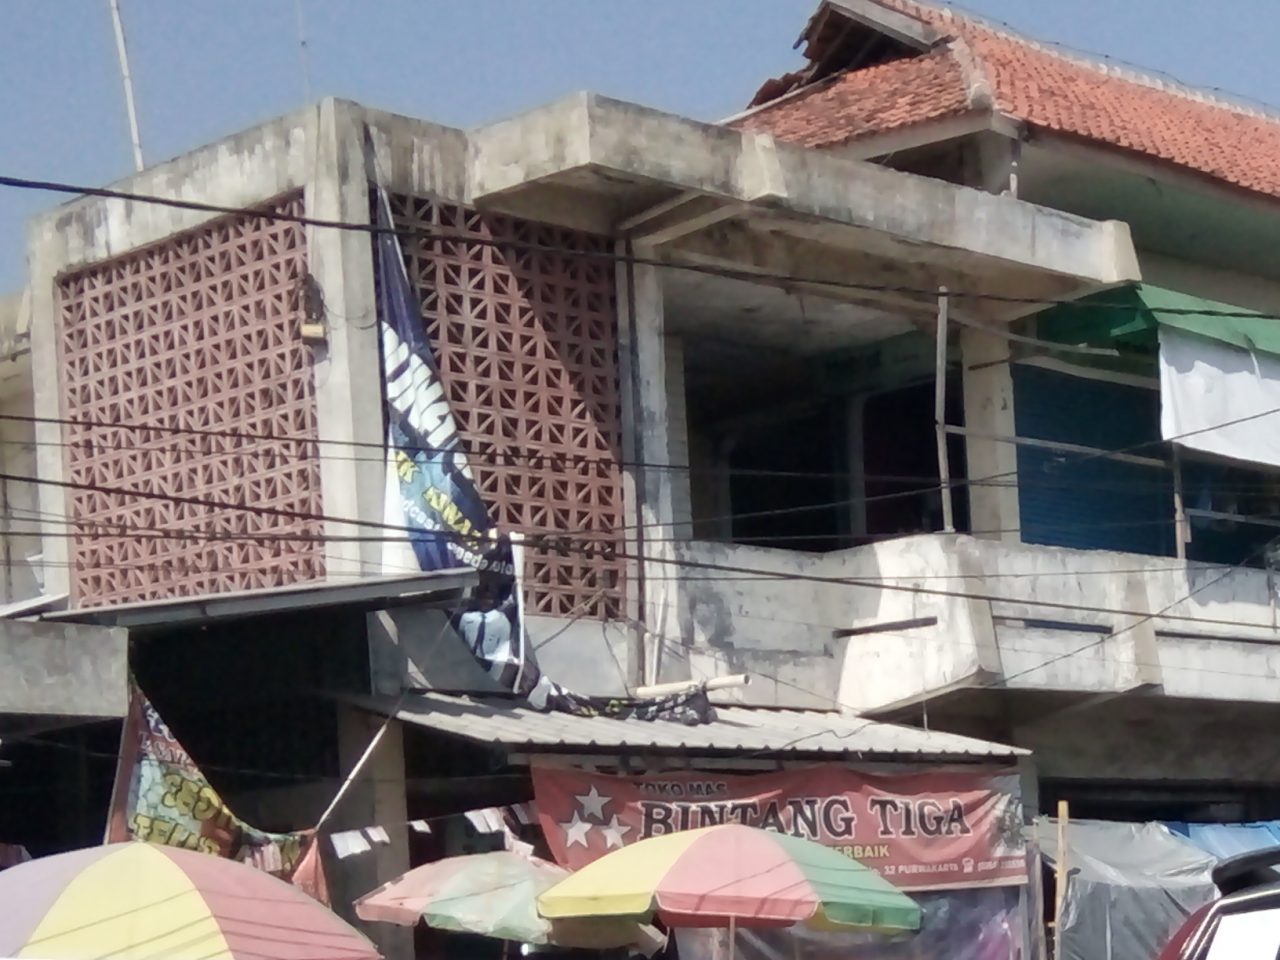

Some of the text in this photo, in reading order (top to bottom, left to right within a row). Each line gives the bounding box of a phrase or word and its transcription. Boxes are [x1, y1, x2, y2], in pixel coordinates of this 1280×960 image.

[633, 781, 729, 797] TOKO MAS
[637, 796, 973, 842] BINTANG TIGA
[834, 844, 890, 859] ERBAIK
[898, 861, 959, 874] PURWAKARTA
